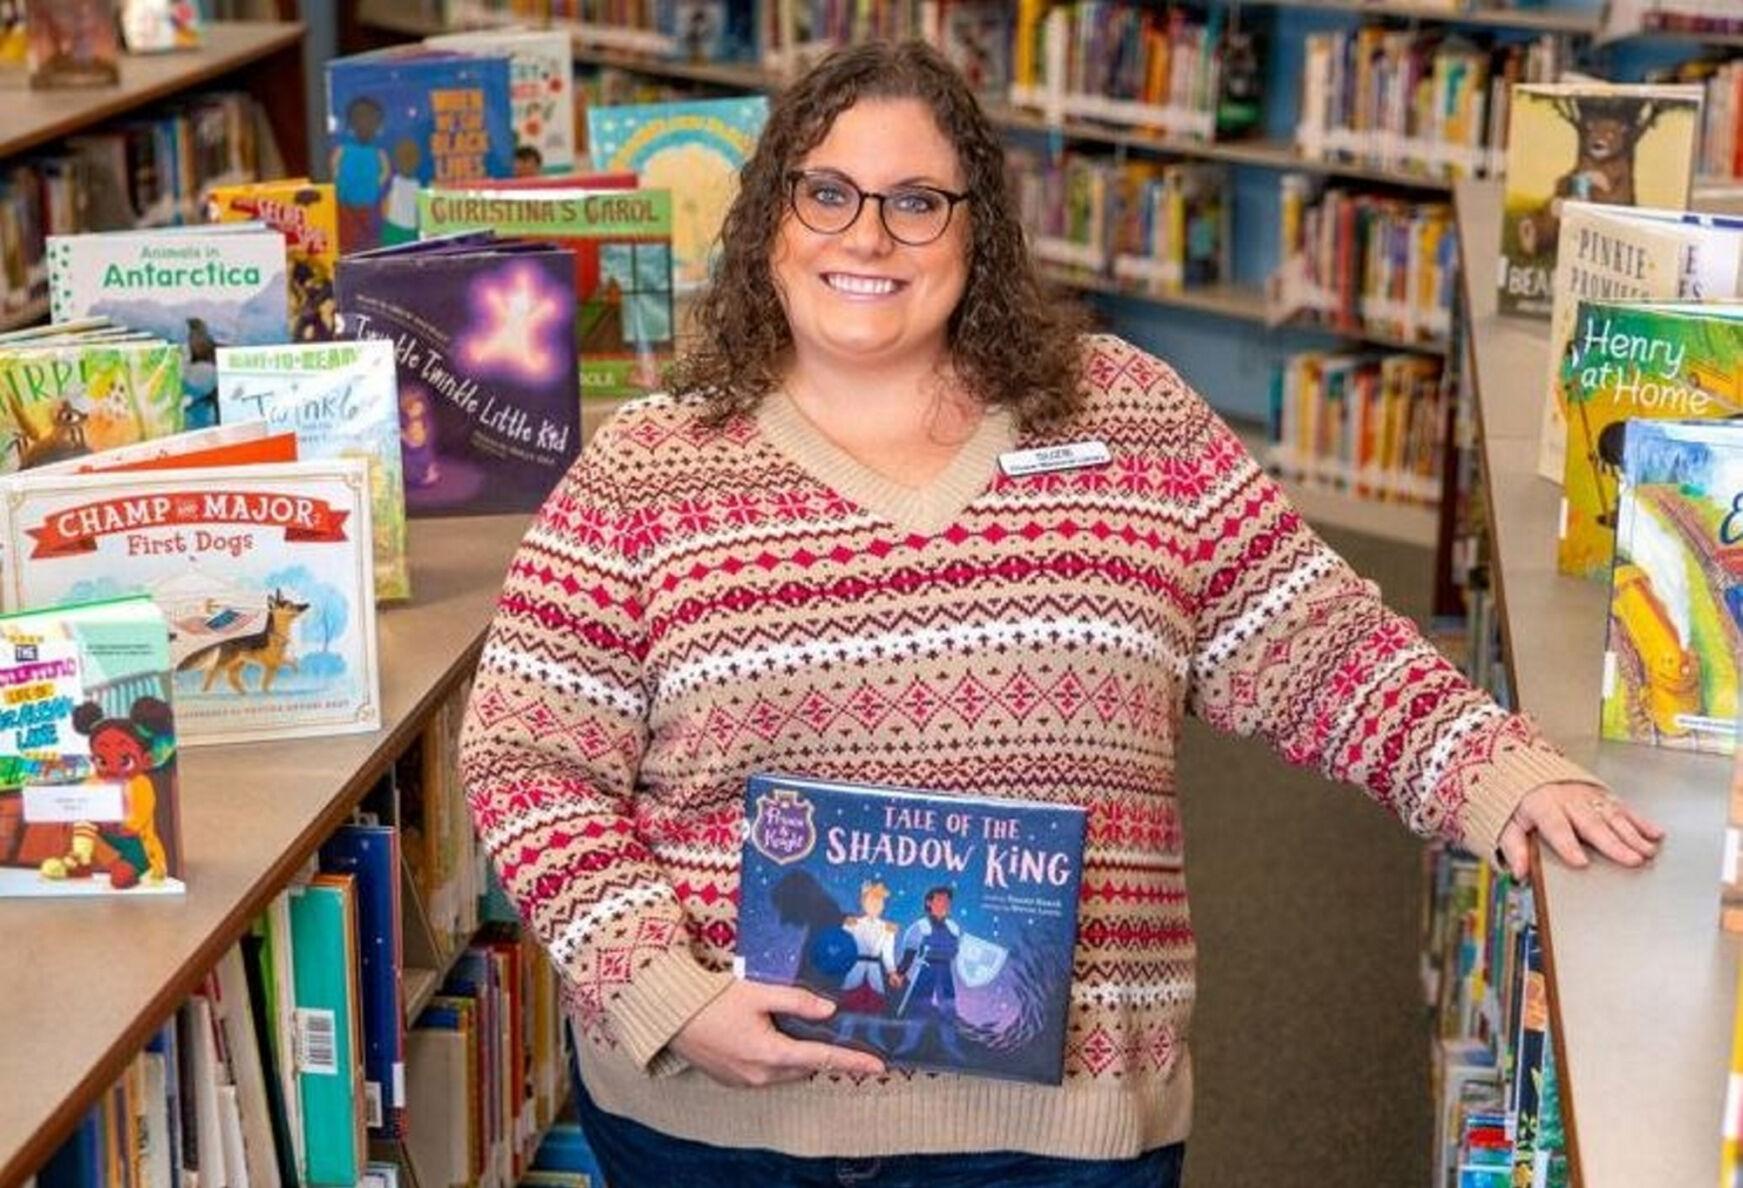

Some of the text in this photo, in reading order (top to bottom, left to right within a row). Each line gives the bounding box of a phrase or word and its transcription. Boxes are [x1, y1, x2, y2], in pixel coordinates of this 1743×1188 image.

[584, 195, 660, 224] CAROL
[139, 244, 220, 260] Animals in
[1579, 228, 1646, 280] PINKIE
[103, 263, 260, 288] Antarctica
[1584, 316, 1685, 379] Henry
[421, 350, 477, 413] Twinkle
[480, 396, 531, 441] Little
[536, 419, 569, 453] Kid
[1581, 362, 1713, 415] at Home
[57, 497, 172, 538] CHAMP
[127, 531, 254, 557] First Dogs
[884, 806, 1021, 840] TALE OF THE
[826, 827, 974, 873] SHADOW
